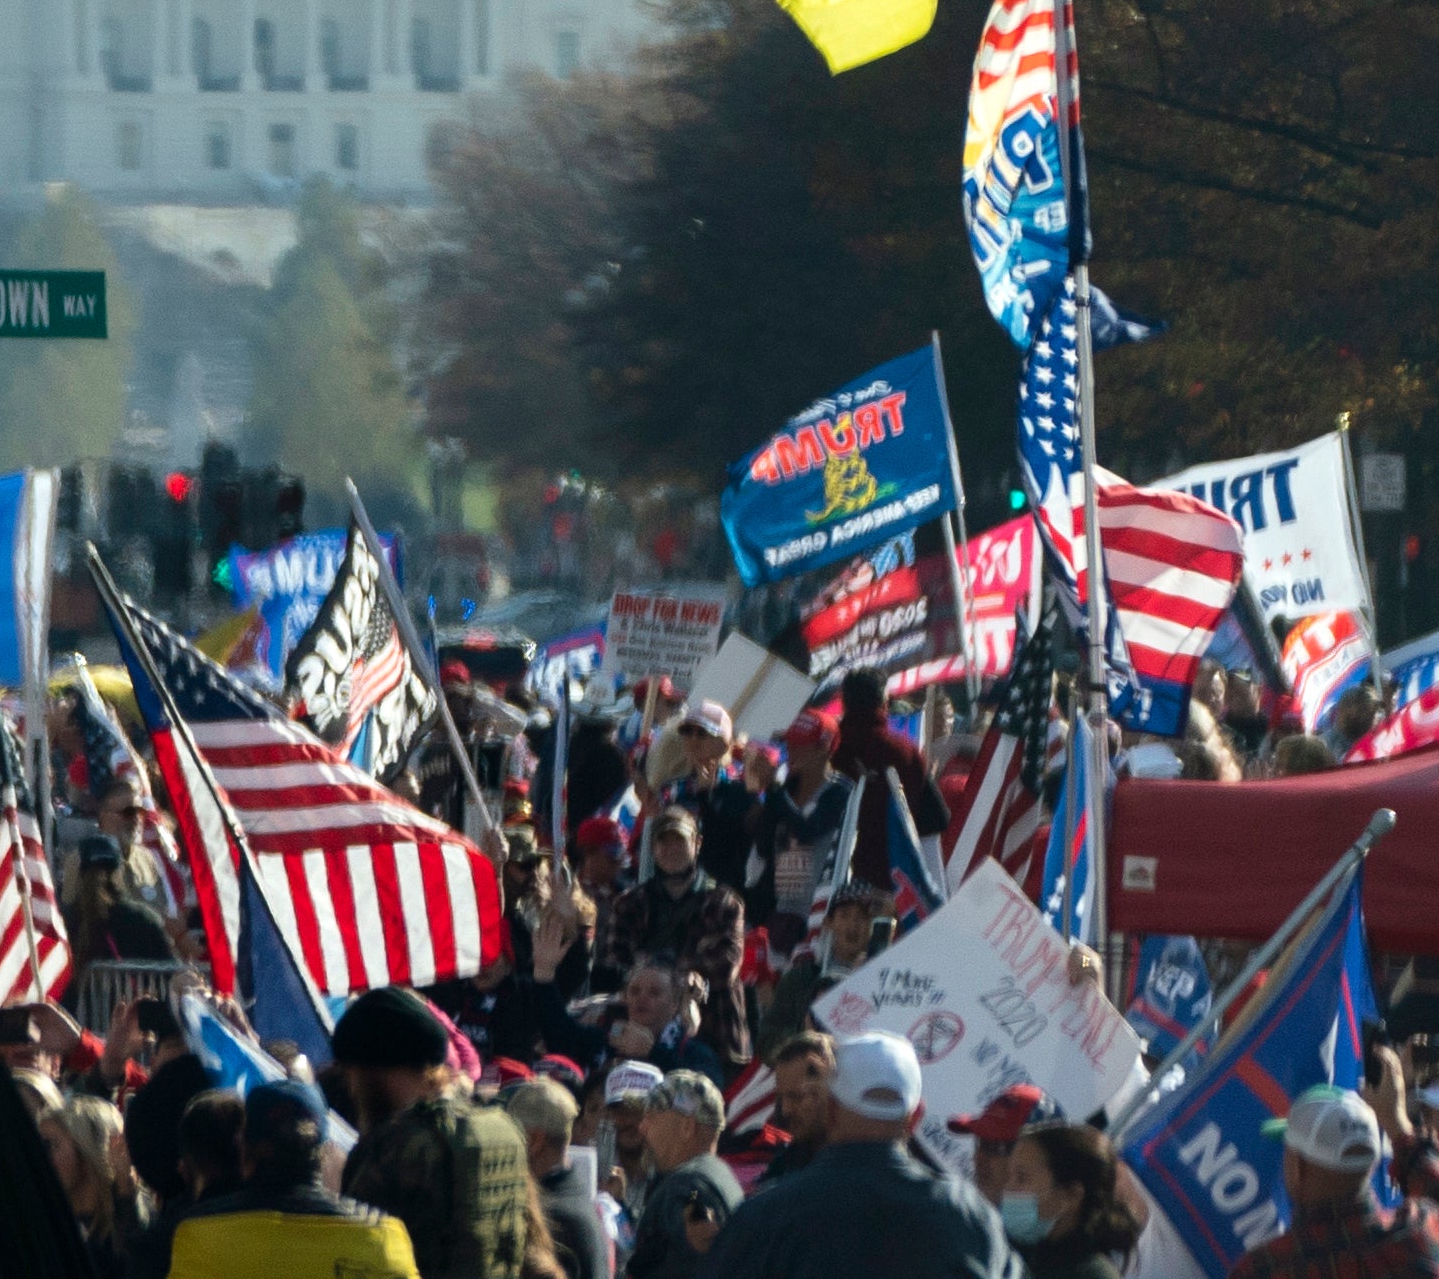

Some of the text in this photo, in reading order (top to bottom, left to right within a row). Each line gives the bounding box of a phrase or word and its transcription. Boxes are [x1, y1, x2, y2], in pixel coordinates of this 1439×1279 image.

[63, 294, 98, 318] WAY
[984, 884, 1075, 994] TRUMP
[978, 975, 1044, 1046] 2020
